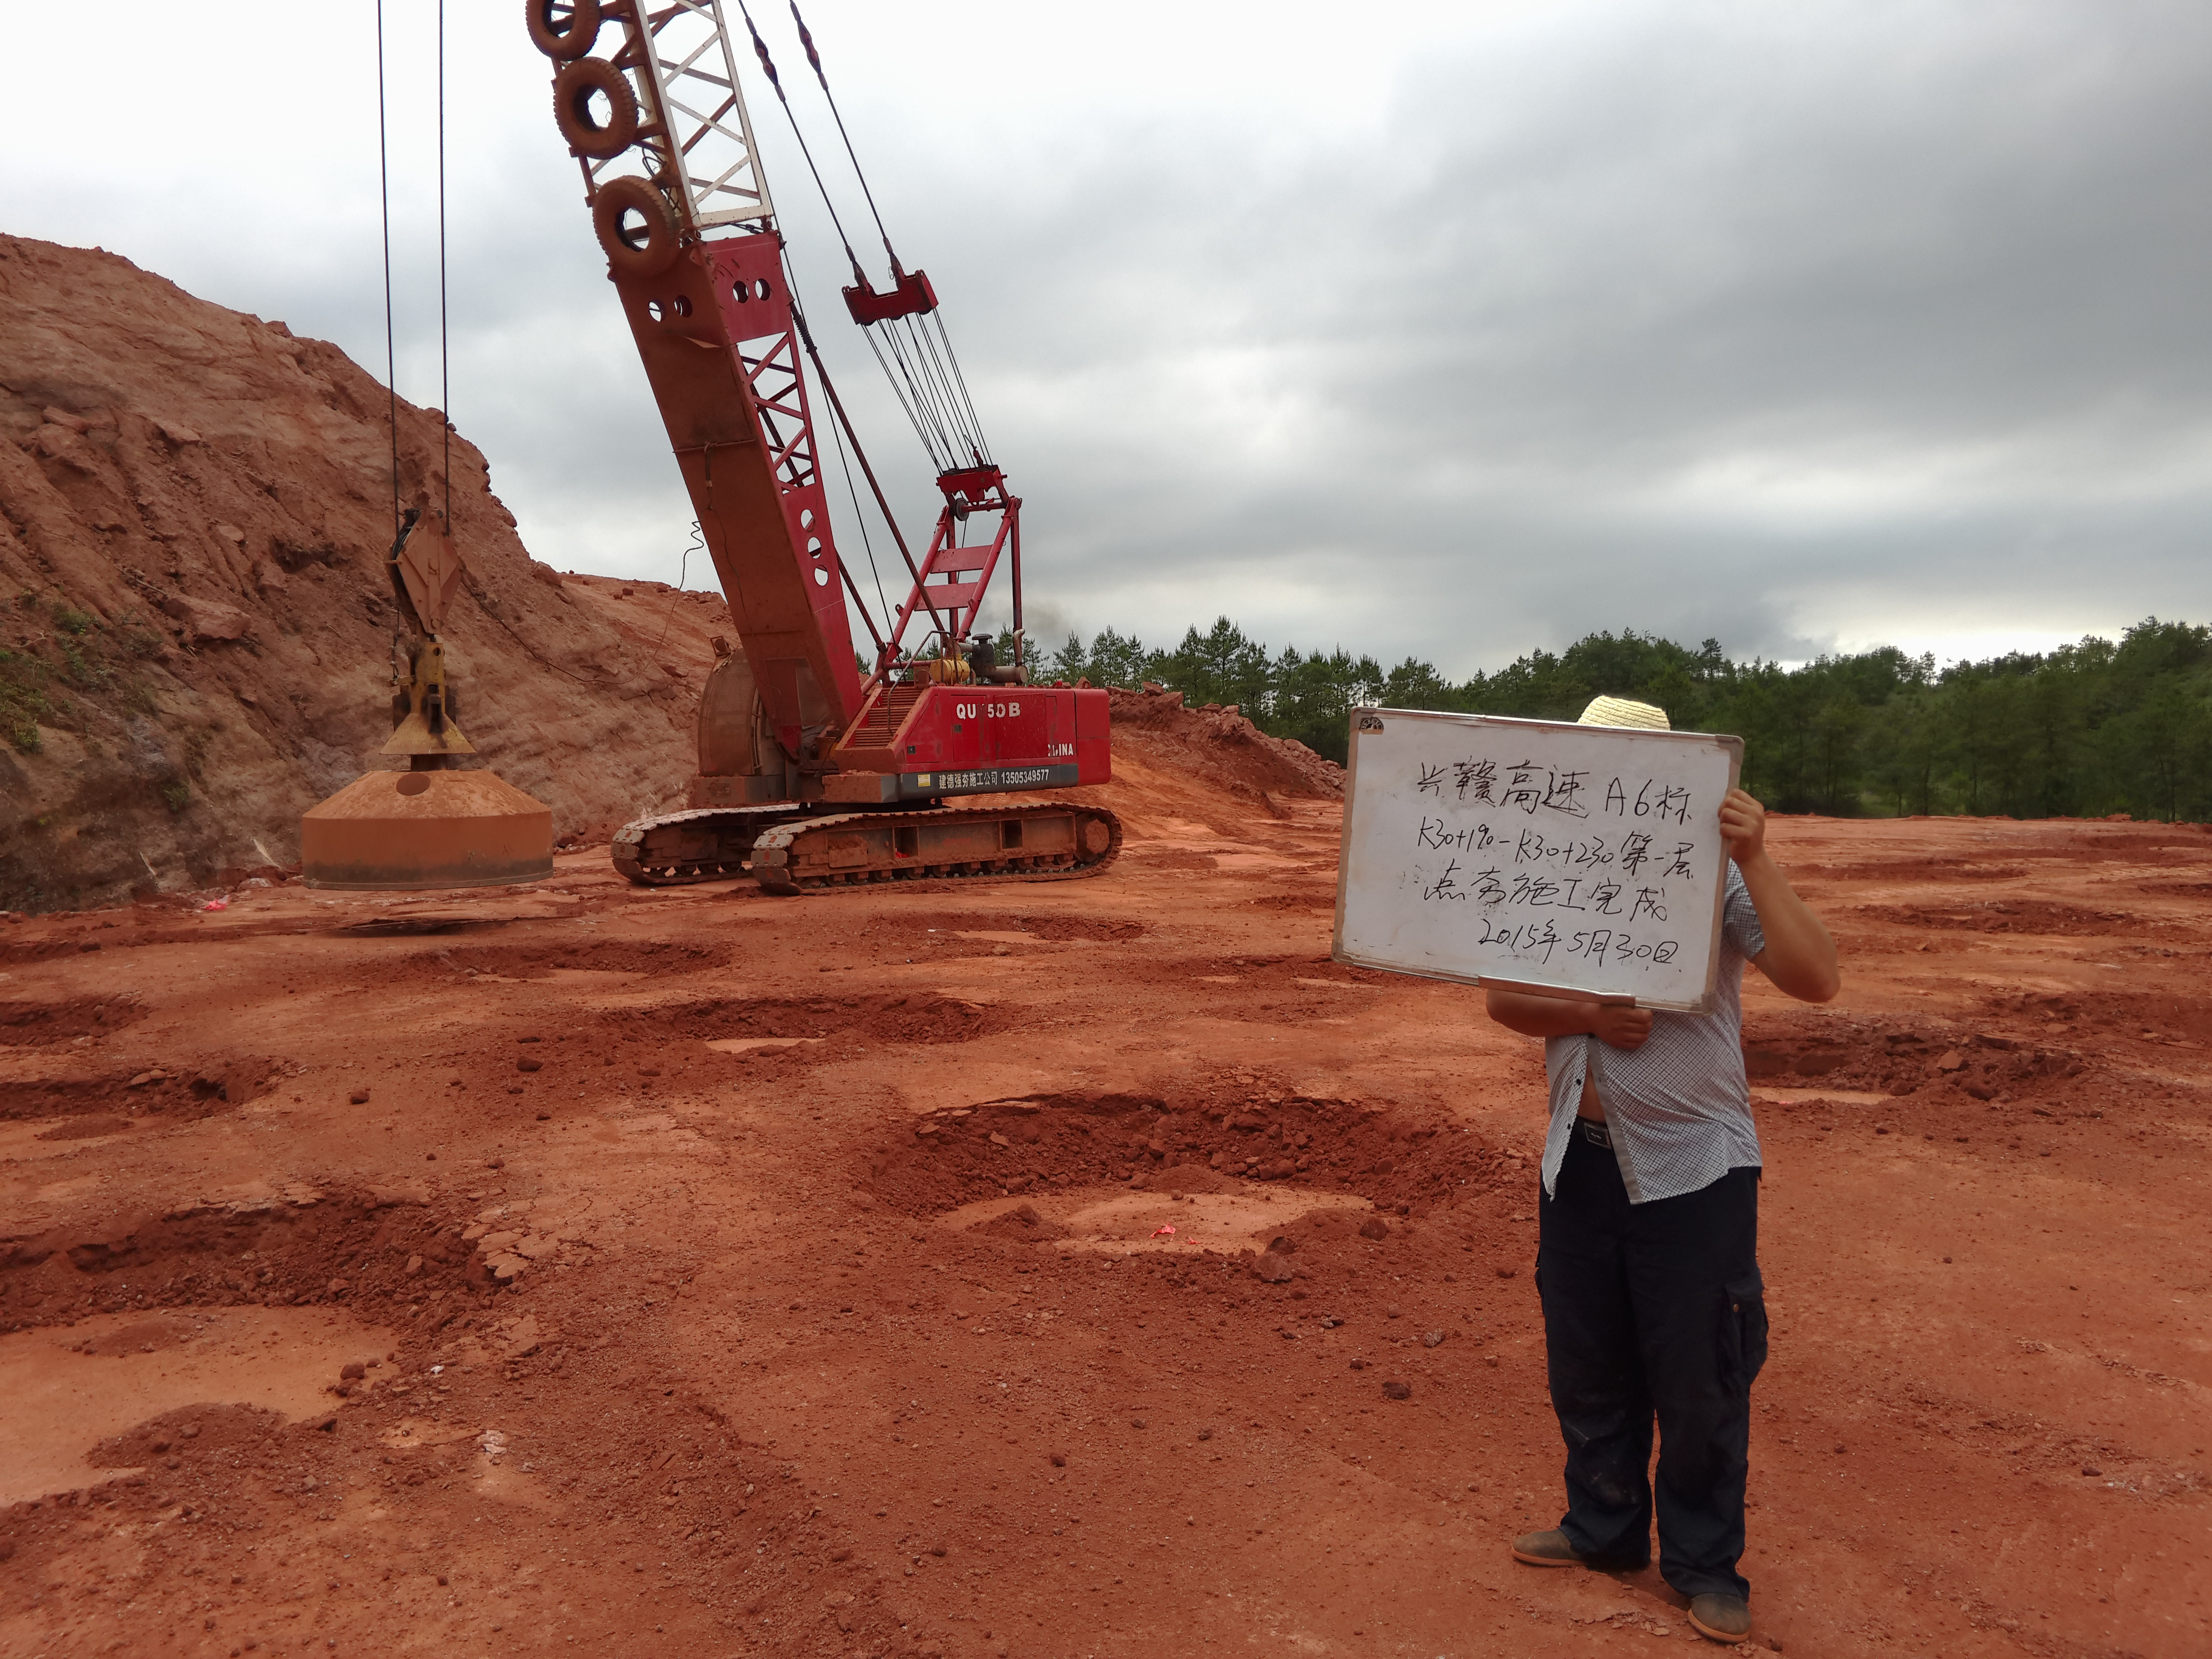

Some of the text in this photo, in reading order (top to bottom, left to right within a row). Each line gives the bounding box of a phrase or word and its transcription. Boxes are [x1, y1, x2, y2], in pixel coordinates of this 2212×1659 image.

[956, 702, 1021, 720] QU50B
[939, 771, 998, 789] 建德强夯施工公司
[1001, 769, 1049, 784] 13505349577
[1417, 755, 1692, 825] 兴赣高速 A6标
[1424, 858, 1667, 922] 点夯施工完成
